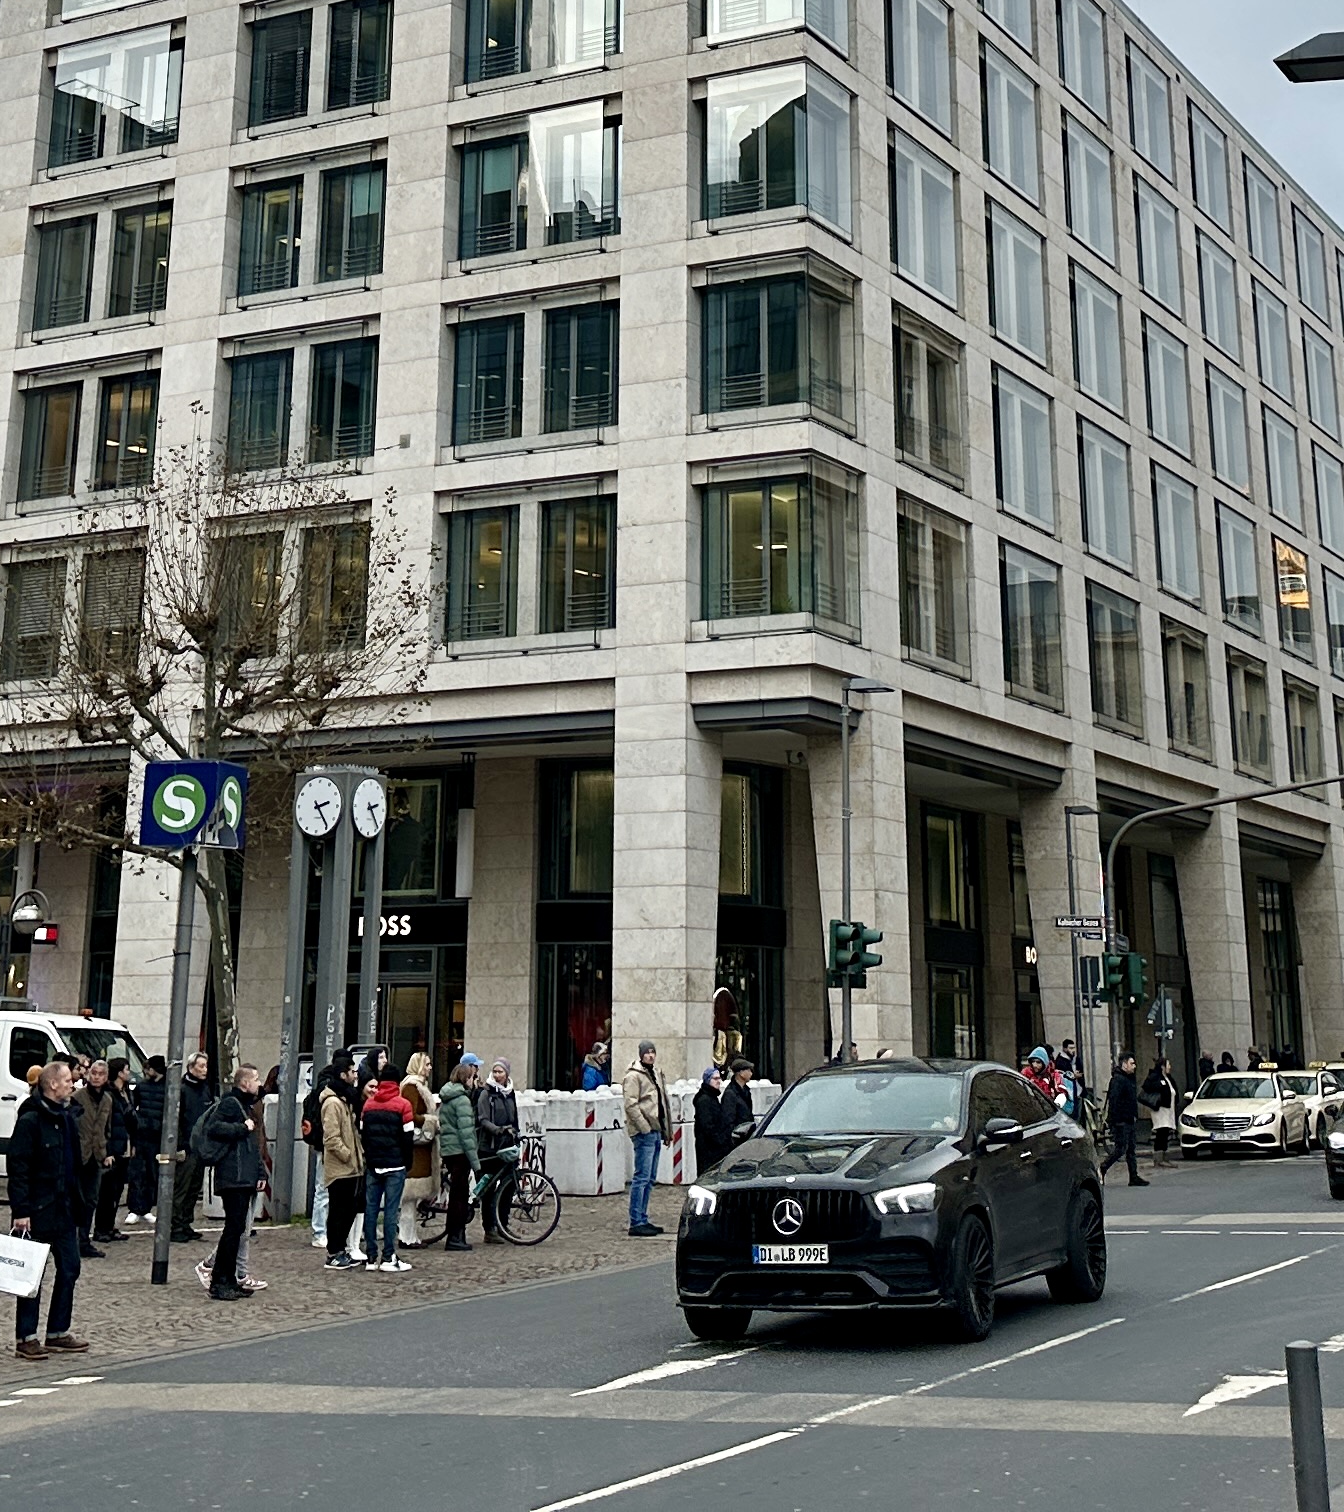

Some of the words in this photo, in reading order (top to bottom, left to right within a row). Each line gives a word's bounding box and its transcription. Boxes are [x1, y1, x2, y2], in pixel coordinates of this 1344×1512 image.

[161, 779, 196, 828] S
[223, 781, 239, 828] S
[760, 1247, 773, 1262] DI
[781, 1247, 796, 1262] LB
[798, 1247, 827, 1262] 999E
